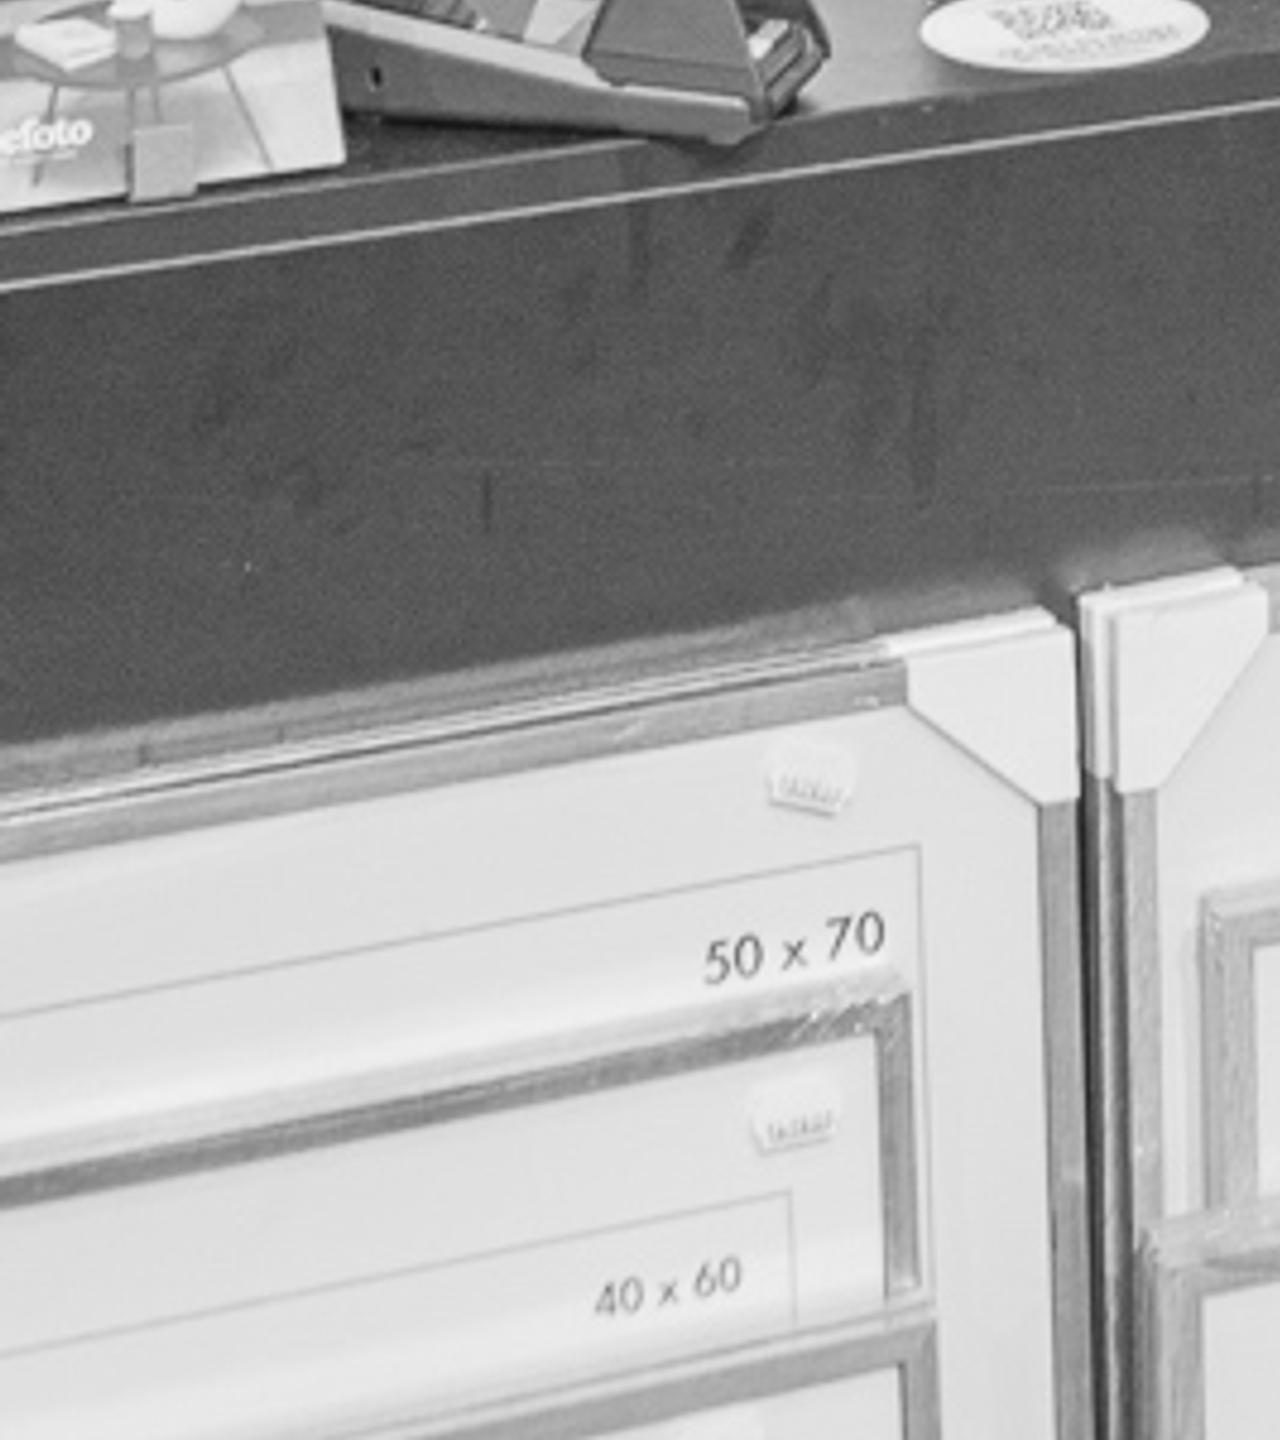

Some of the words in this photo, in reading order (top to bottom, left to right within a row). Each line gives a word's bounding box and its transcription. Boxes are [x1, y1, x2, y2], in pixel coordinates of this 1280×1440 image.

[705, 932, 765, 985] 50
[781, 939, 807, 971] x
[825, 909, 886, 960] 70
[594, 1275, 645, 1317] 40
[693, 1255, 743, 1298] 60
